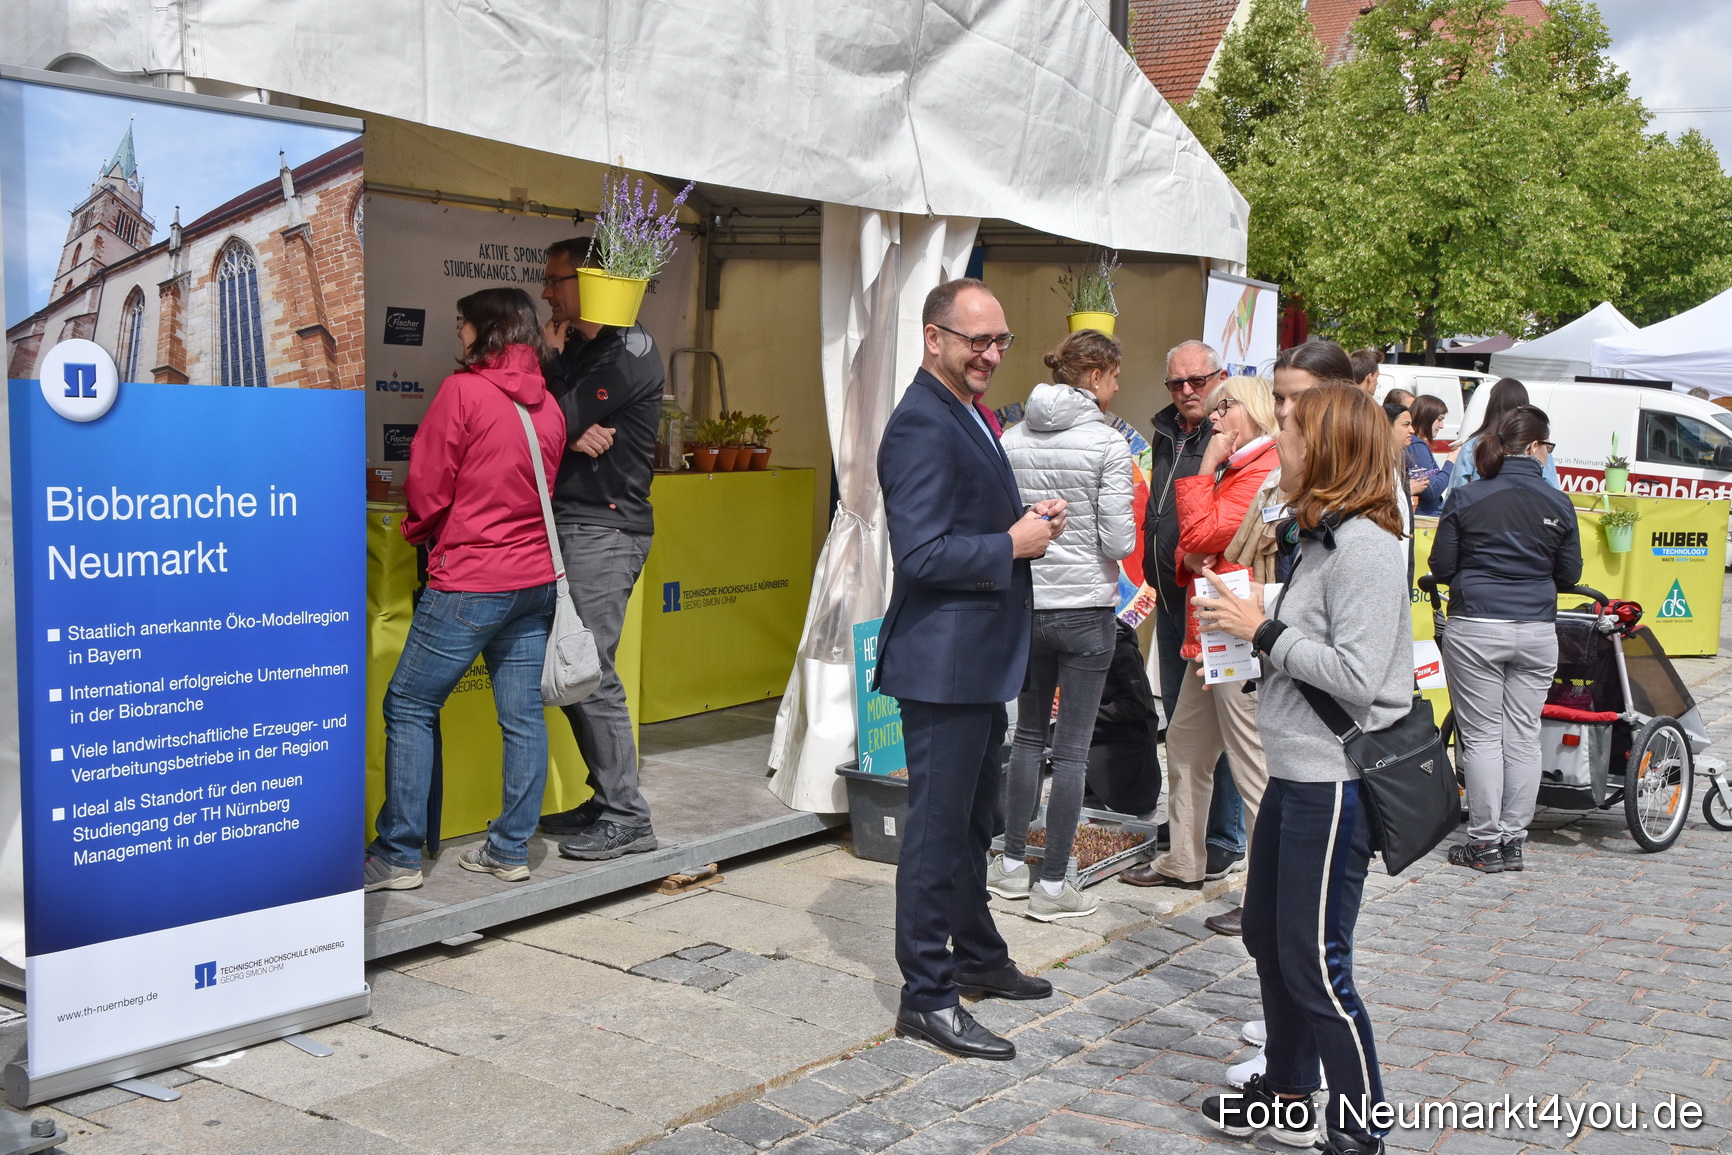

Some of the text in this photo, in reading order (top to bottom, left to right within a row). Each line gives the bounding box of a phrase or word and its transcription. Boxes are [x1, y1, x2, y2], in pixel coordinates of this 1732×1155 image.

[479, 243, 509, 262] AKTIVE
[444, 260, 517, 283] STUDIENGANGES
[392, 318, 419, 328] Fischer
[401, 392, 424, 400] energie
[46, 484, 297, 522] Biobranche in
[1651, 532, 1708, 547] HUBER
[48, 540, 228, 581] Neumarkt
[682, 579, 789, 599] TECHNISCHE HOCHSCHULE NÜRNBERG
[683, 595, 737, 611] GEORG SIMON OHM
[68, 610, 349, 641] Staatlich anerkannte Öko-Modellregion
[68, 647, 142, 666] in Bayern
[70, 663, 349, 701] International erfolgreiche Unternehmen
[1417, 666, 1432, 677] DEHN
[70, 697, 204, 725] in der Biobranche
[867, 695, 901, 723] MORGE
[70, 713, 347, 760] Viele landwirtschaftliche Erzeuger- und
[868, 721, 903, 753] ERNTEN
[71, 740, 329, 785] Verarbeitungsbetriebe in der Region
[71, 775, 303, 820] Ideal als Standort für den neuen
[73, 798, 290, 843] Studiengang der TH Nürnberg
[73, 817, 300, 866] Management in der Biobranche
[220, 940, 345, 975] TECHNISCHE HOCHSCHULE NÜRNBERG
[220, 962, 284, 985] GEORG SIMON OHM
[57, 990, 159, 1023] www.th-nuernberg.de
